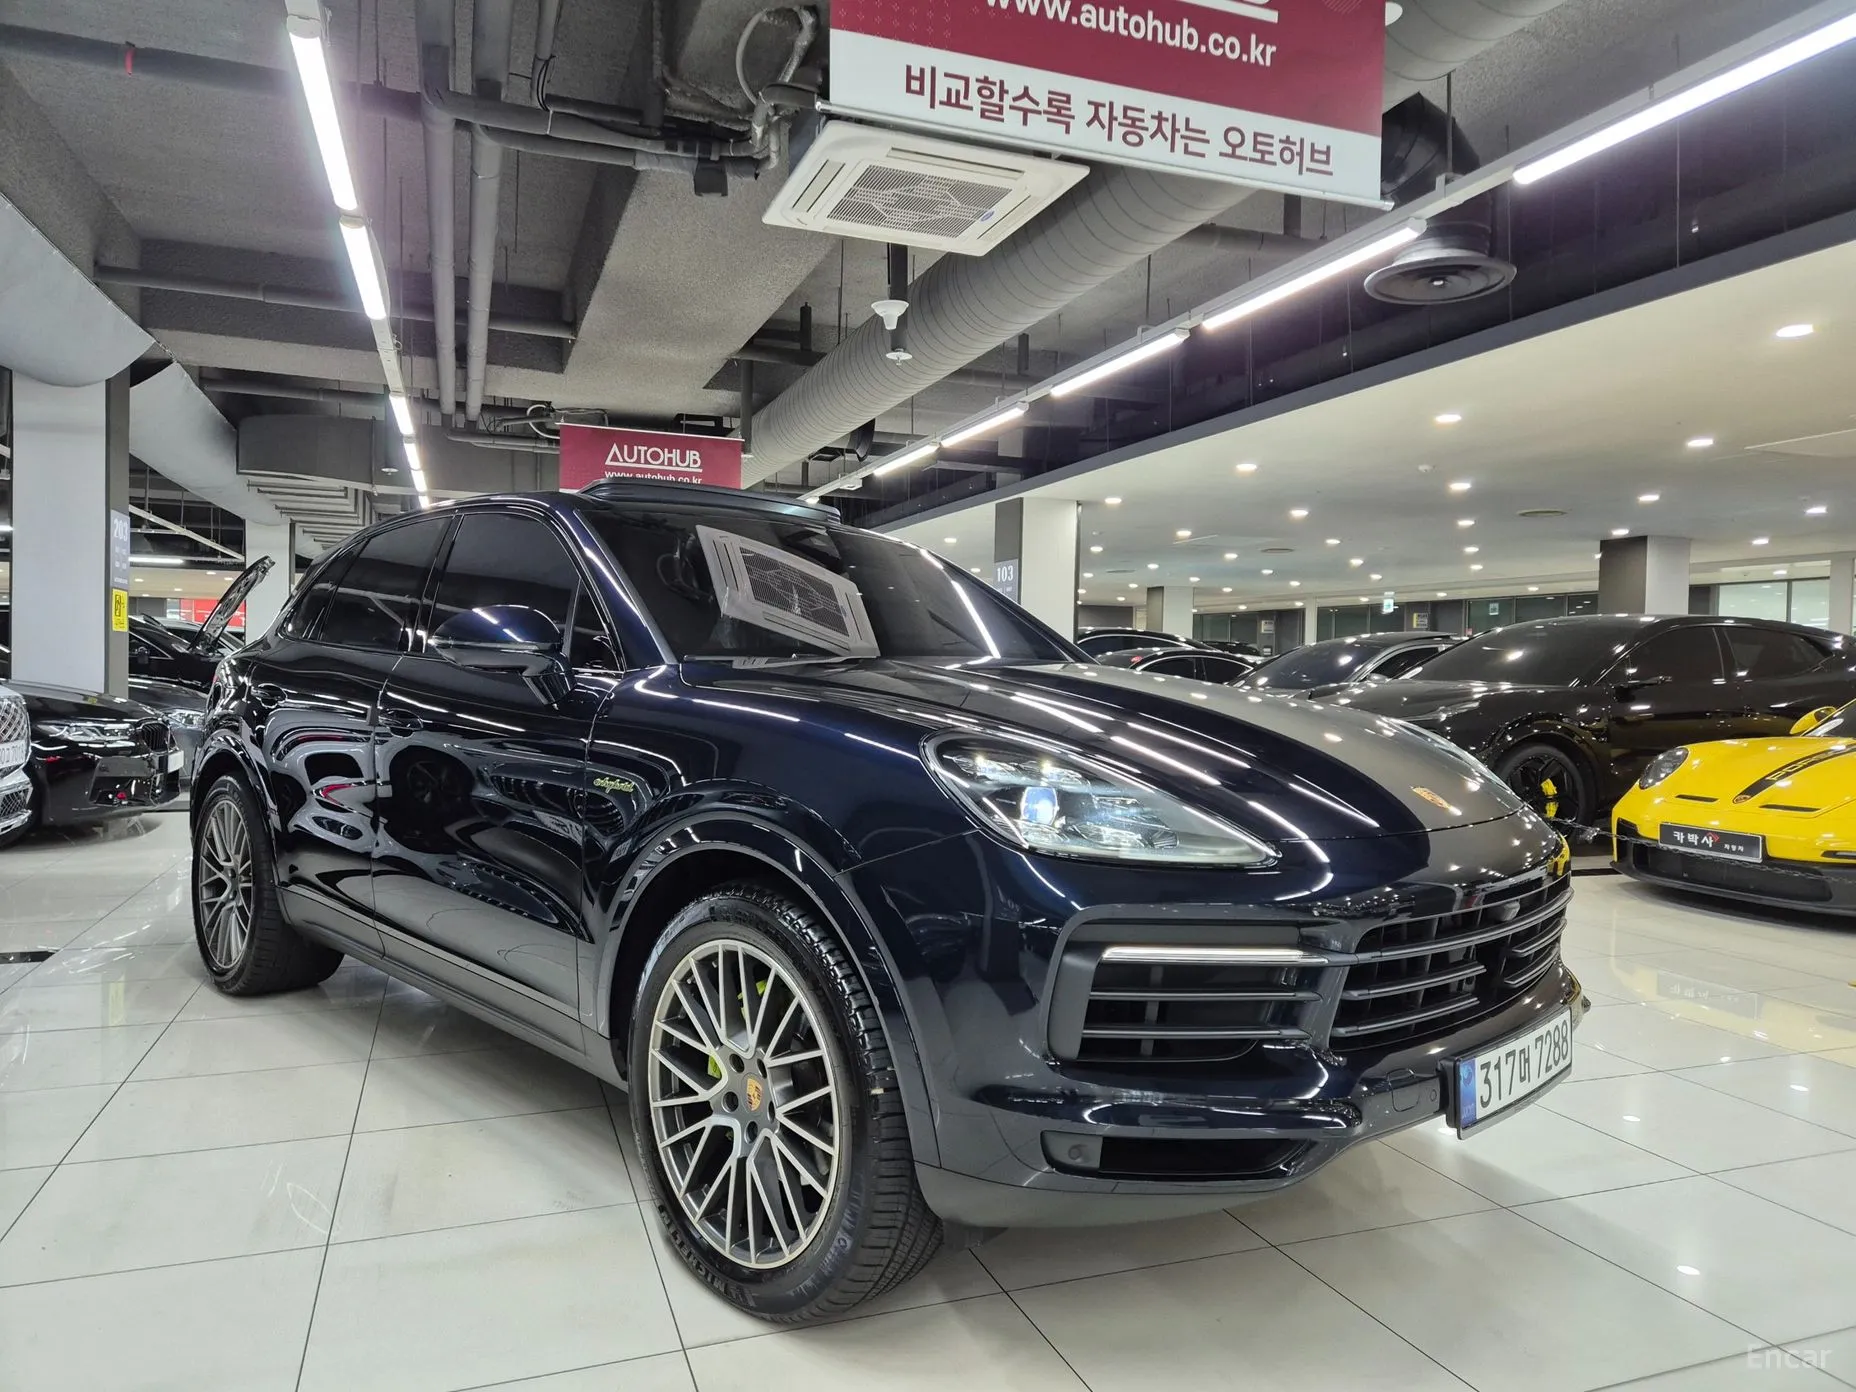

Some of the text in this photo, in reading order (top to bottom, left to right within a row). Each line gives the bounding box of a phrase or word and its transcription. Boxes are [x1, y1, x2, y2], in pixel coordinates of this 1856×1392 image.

[904, 64, 1334, 176] 비교할수록 자동차는 오토허브
[605, 443, 702, 471] AUTOHUB
[996, 565, 1014, 582] 103
[1480, 1019, 1569, 1109] 317머 7288
